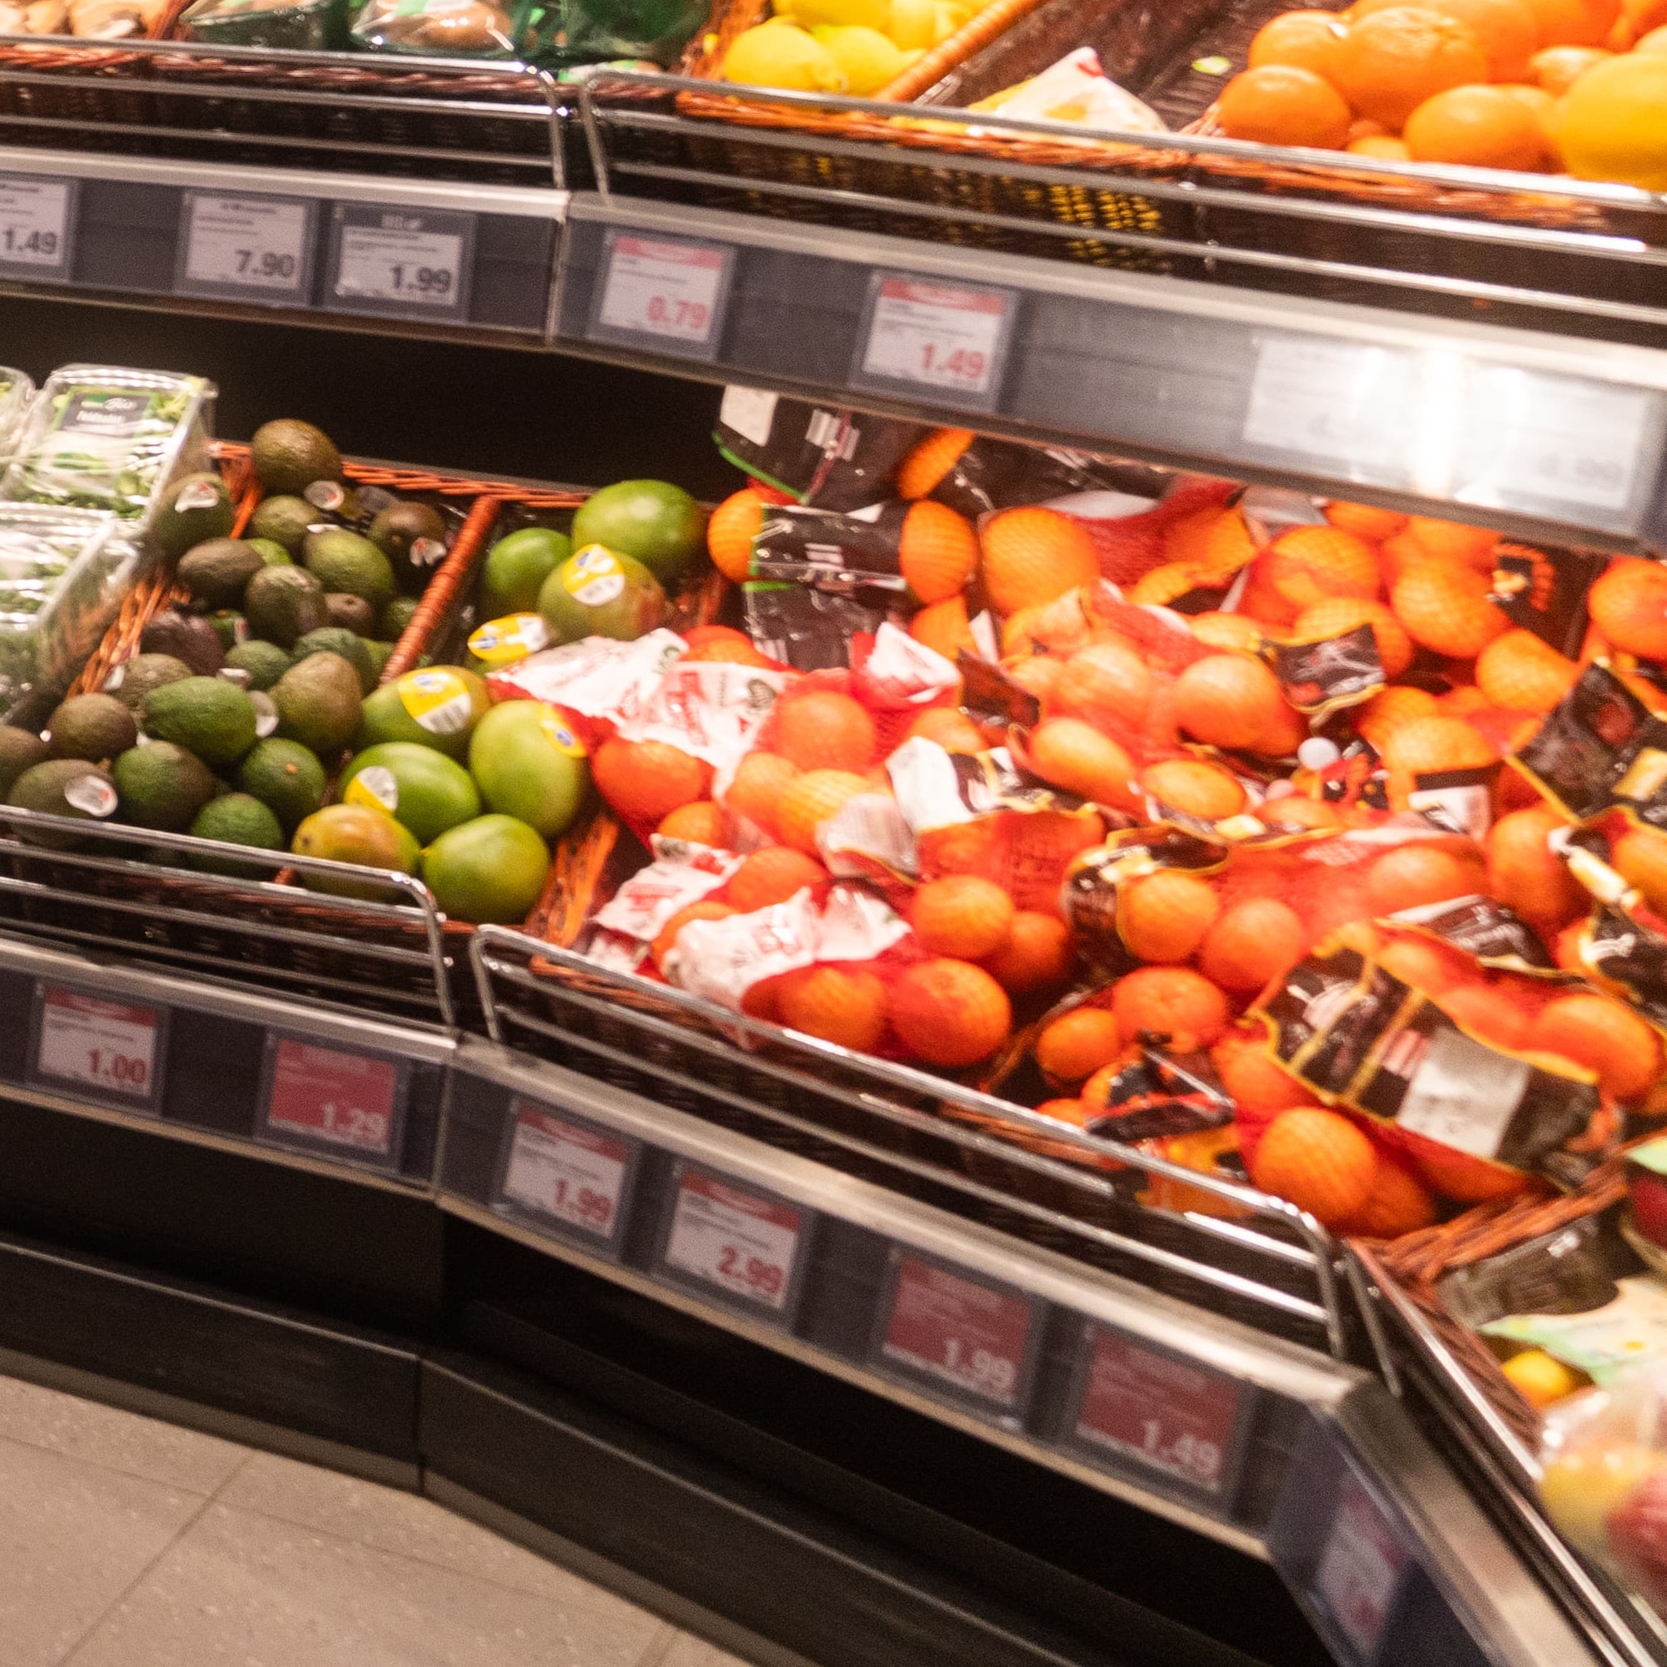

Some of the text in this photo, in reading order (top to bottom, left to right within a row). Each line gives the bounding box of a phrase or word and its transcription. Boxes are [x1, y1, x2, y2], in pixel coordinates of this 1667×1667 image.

[3, 226, 58, 255] 1.49
[236, 249, 294, 279] 7.90
[390, 263, 451, 294] 1.99
[647, 295, 708, 330] 0.79
[919, 342, 985, 381] 1.49
[88, 1048, 147, 1084] 1.00
[320, 1100, 386, 1139] 1.29
[553, 1177, 611, 1224] 1.99
[717, 1244, 783, 1295] 2.99
[943, 1337, 1013, 1387] 1.99
[1142, 1418, 1221, 1472] 1.49
